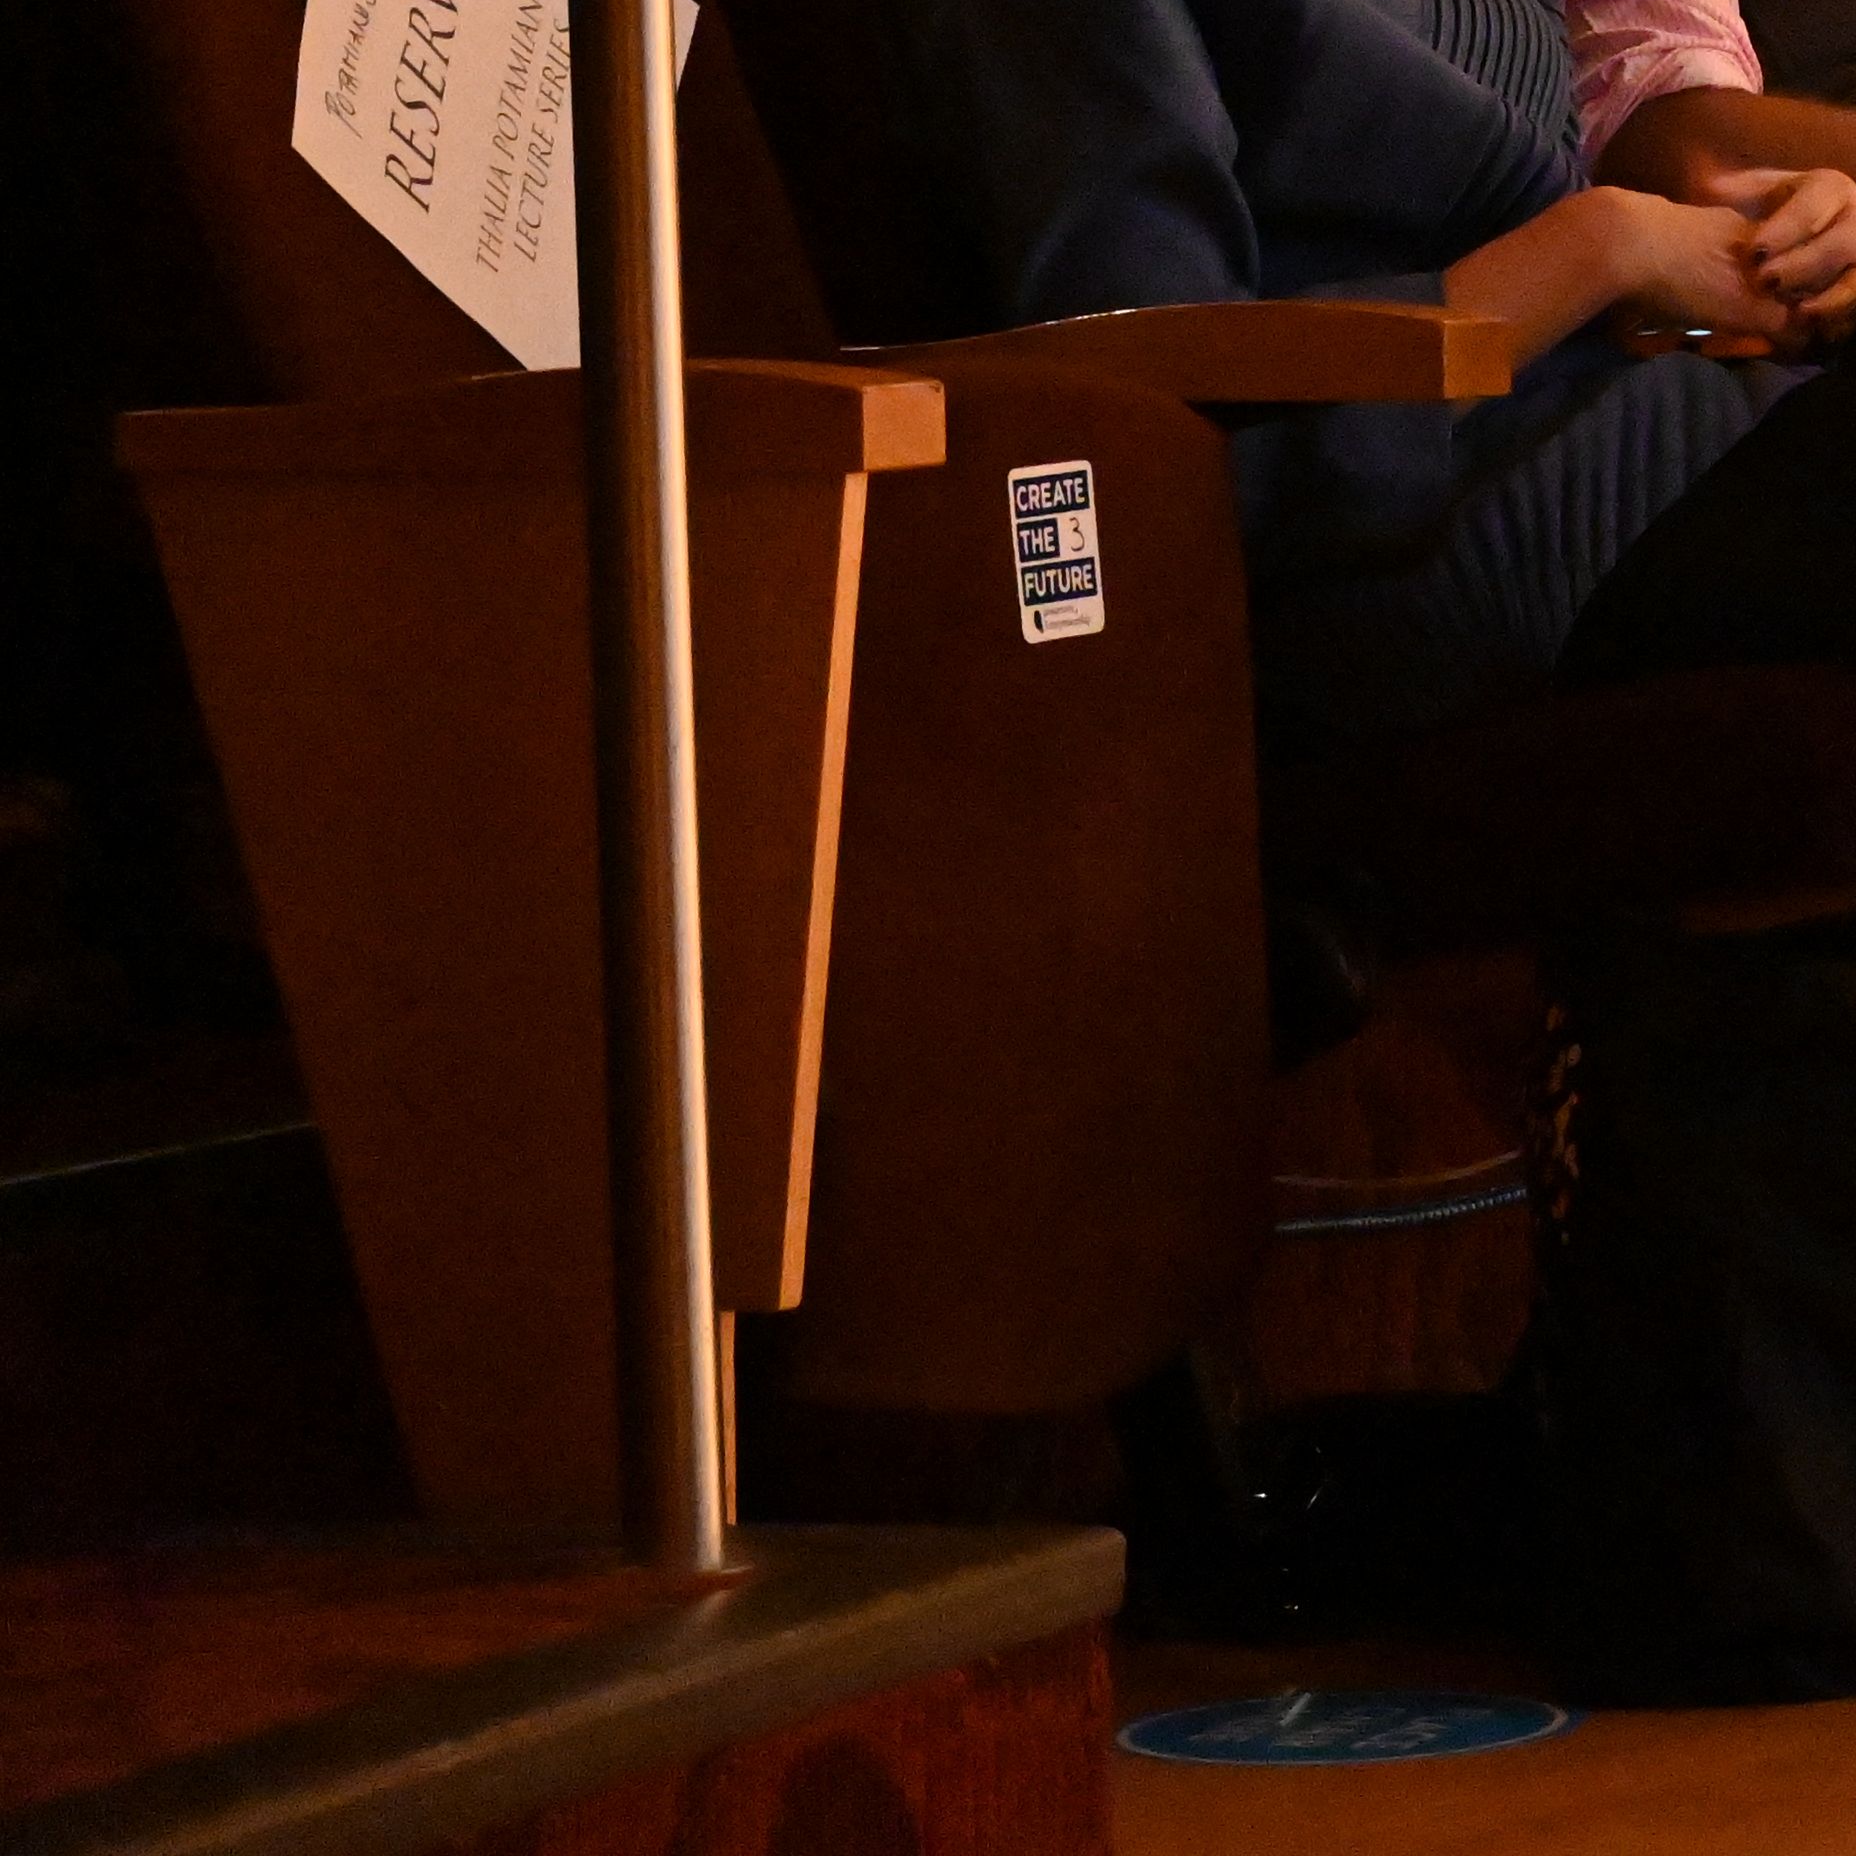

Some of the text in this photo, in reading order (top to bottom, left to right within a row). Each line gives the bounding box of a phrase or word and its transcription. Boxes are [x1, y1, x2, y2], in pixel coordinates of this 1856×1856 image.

[513, 17, 570, 263] LECTURE SERIES
[476, 165, 512, 274] THALIA
[1016, 477, 1086, 511] CREATE
[1019, 526, 1056, 555] THE
[1069, 517, 1085, 551] 3
[1024, 564, 1094, 598] FUTURE
